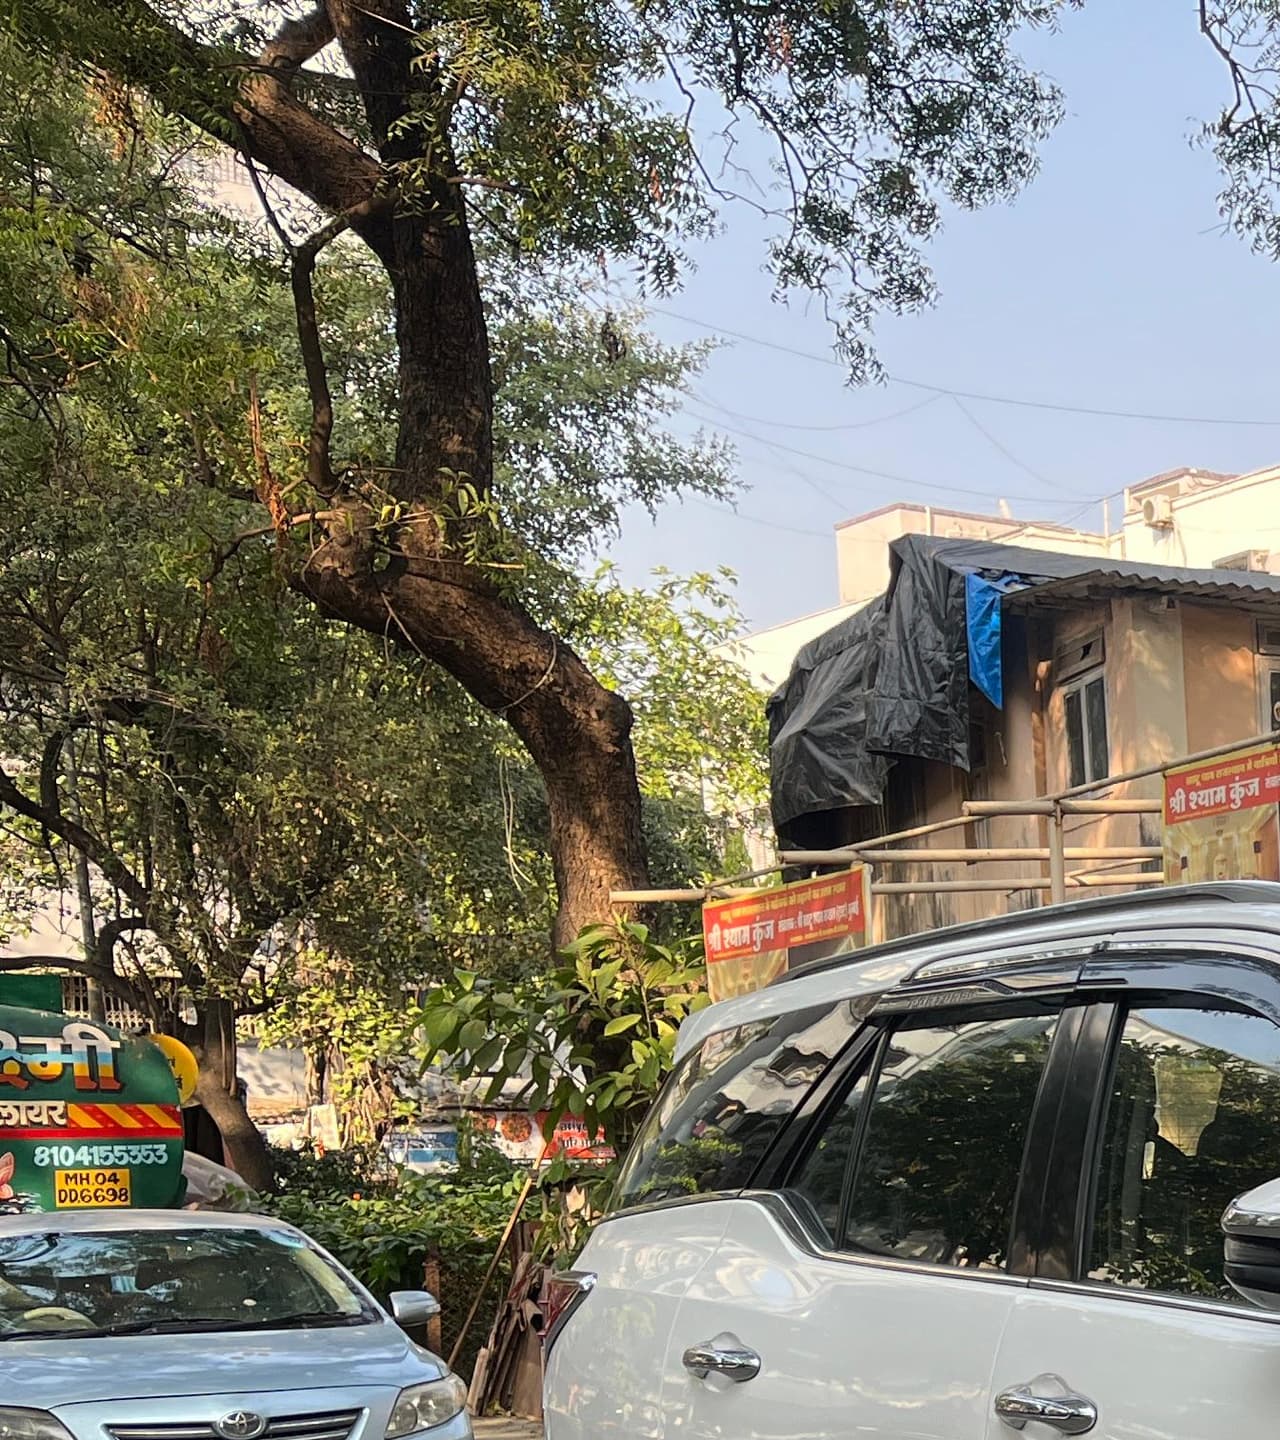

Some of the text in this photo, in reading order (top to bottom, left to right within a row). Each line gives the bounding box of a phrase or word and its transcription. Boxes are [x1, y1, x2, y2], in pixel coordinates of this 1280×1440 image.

[1169, 787, 1186, 814] श्री
[1188, 785, 1227, 810] श्याम
[1229, 775, 1260, 810] कुंज
[707, 922, 722, 952] श्री
[722, 925, 750, 949] श्याम
[33, 1144, 169, 1167] 8104155353
